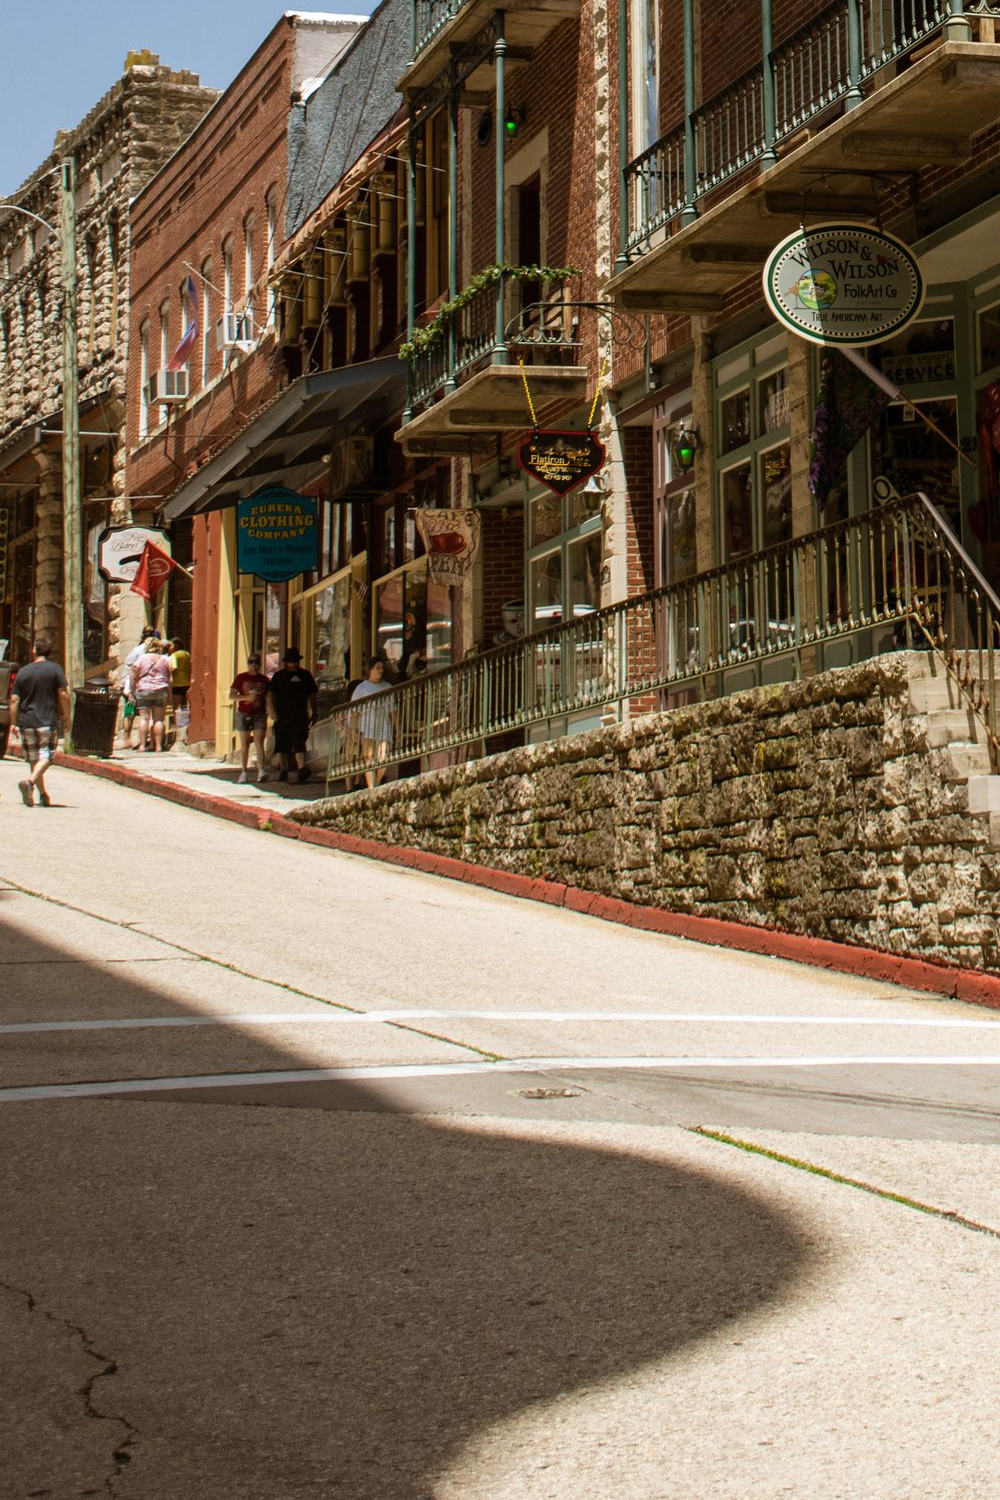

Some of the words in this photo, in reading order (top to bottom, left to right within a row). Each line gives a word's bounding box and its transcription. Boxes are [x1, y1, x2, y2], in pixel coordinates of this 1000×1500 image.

[789, 239, 861, 268] WILSON
[860, 246, 873, 261] &
[828, 260, 899, 280] WILSON
[812, 312, 828, 322] TRUE
[831, 313, 868, 322] AMERICANA
[870, 312, 883, 322] ART
[886, 363, 954, 382] SERVICE
[530, 454, 565, 466] Flatiron
[251, 503, 302, 515] EUREKA
[240, 515, 314, 529] CLOTHING
[248, 528, 305, 539] COMPANY
[428, 553, 465, 577] PEN
